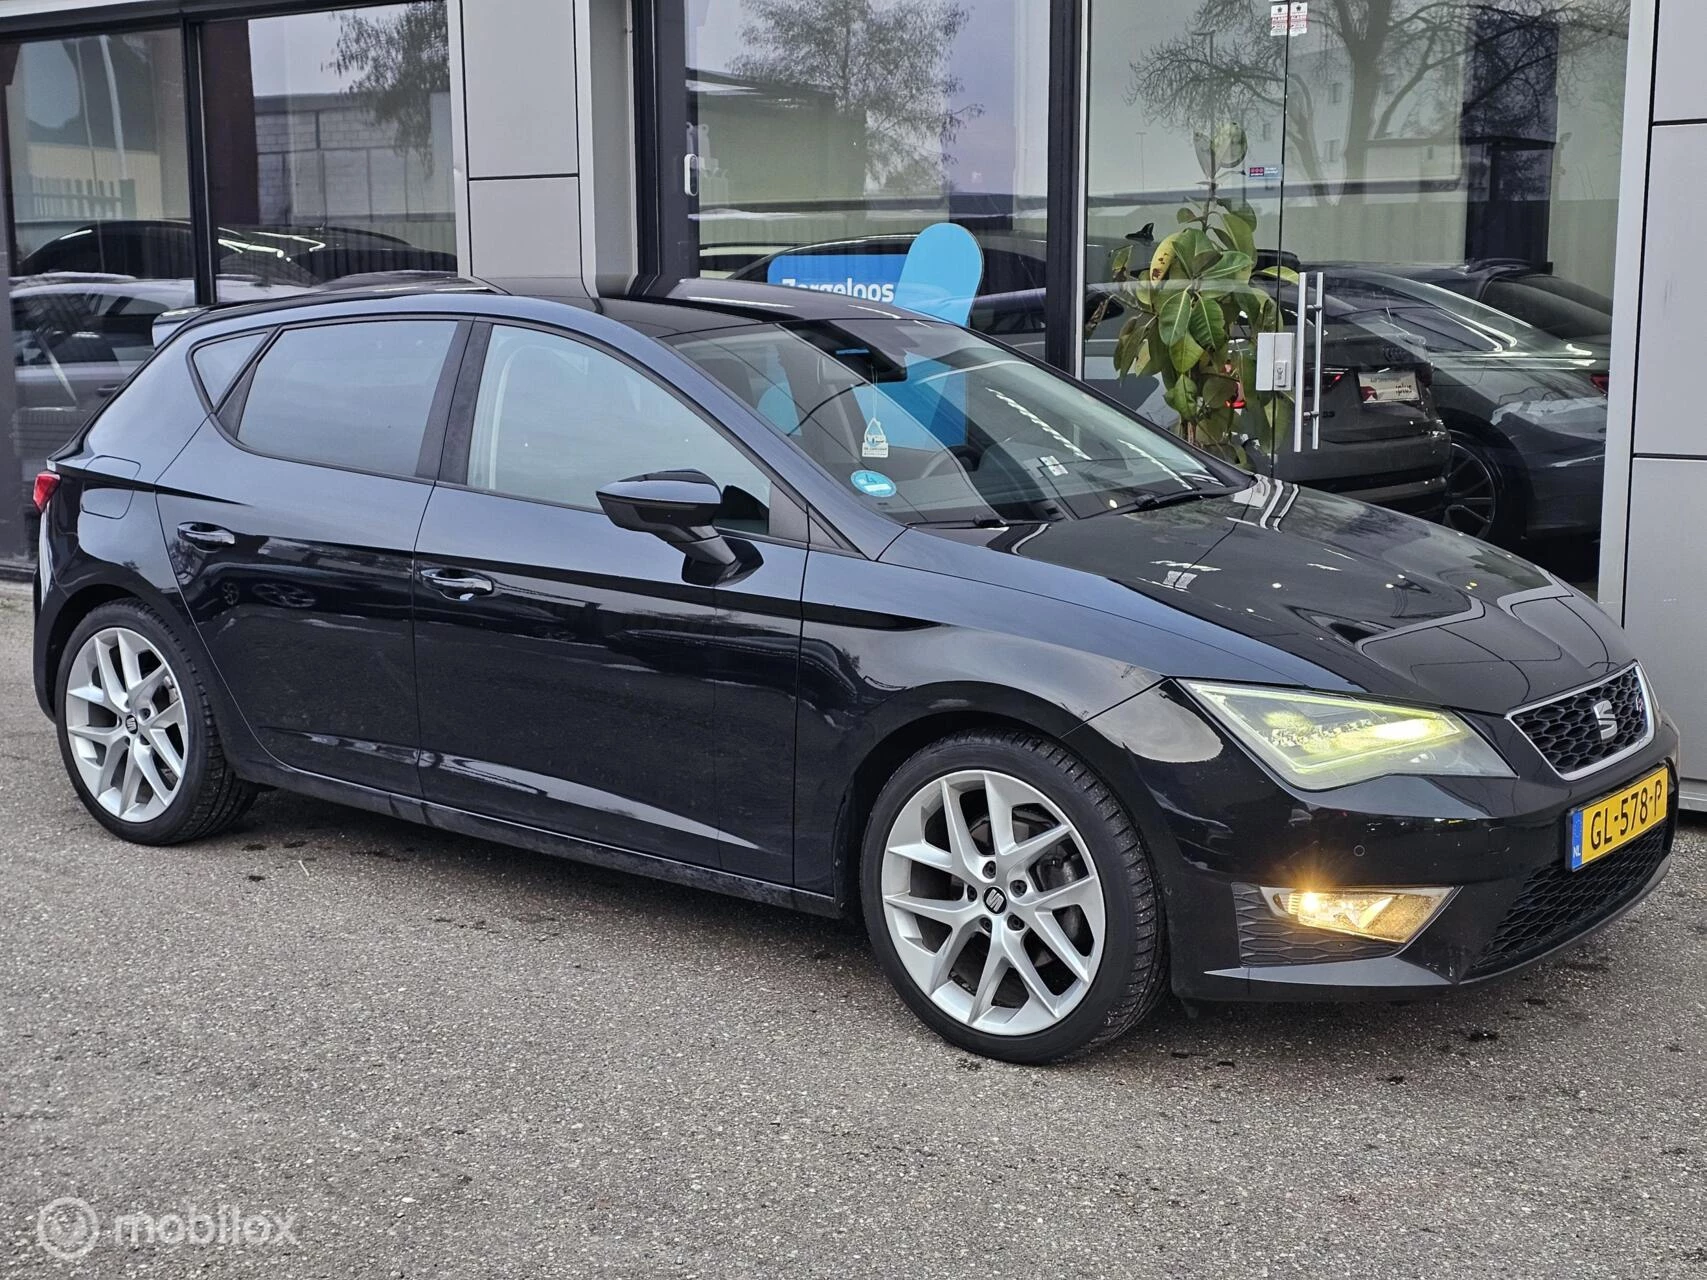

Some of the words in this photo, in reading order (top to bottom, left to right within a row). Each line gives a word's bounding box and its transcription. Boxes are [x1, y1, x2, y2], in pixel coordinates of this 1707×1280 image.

[782, 278, 895, 303] eloos
[1590, 779, 1663, 851] GL-578-P
[1572, 844, 1582, 859] NL
